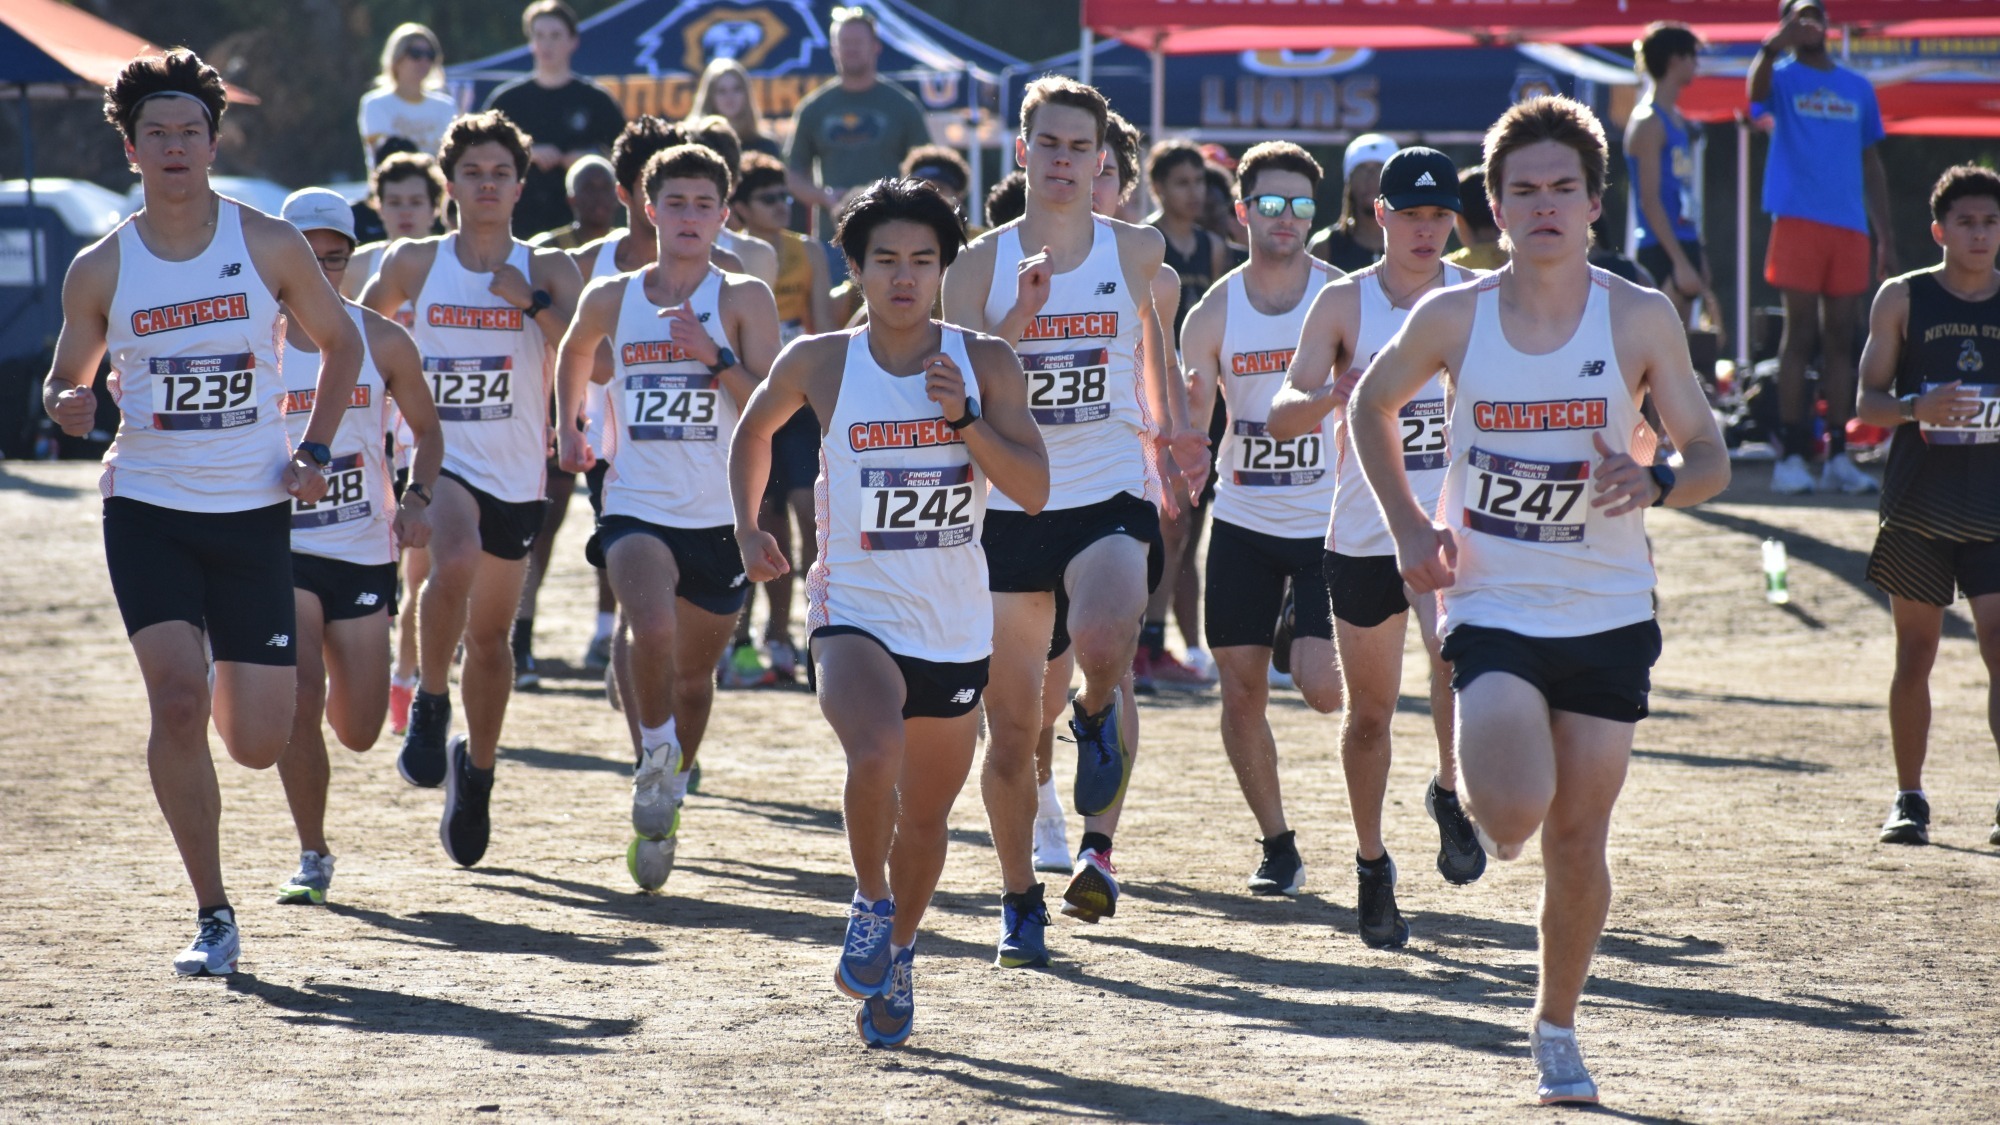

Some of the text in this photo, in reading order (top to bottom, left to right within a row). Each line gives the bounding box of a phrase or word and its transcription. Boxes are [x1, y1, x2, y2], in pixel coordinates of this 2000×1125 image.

[1202, 77, 1379, 128] LIONS
[132, 293, 249, 337] CALTECH
[428, 303, 524, 331] CALTECH
[1020, 312, 1119, 342] ALTECH
[1924, 323, 1978, 343] NEVADA
[622, 340, 699, 367] CALTE
[1044, 361, 1074, 370] RESULTS
[1045, 354, 1075, 362] FINISHED
[163, 372, 253, 411] 1239
[432, 373, 510, 404] 1234
[1025, 367, 1106, 406] 238
[635, 391, 716, 422] 1243
[1414, 408, 1443, 416] RESULTS
[1474, 398, 1608, 432] CALTECH
[849, 417, 966, 453] CALTEC
[1402, 416, 1447, 452] 23
[1242, 436, 1319, 469] 1250
[1514, 461, 1550, 471] FINISHED
[1512, 469, 1548, 480] RESULTS
[874, 486, 972, 528] 1242
[1477, 473, 1585, 522] 1247
